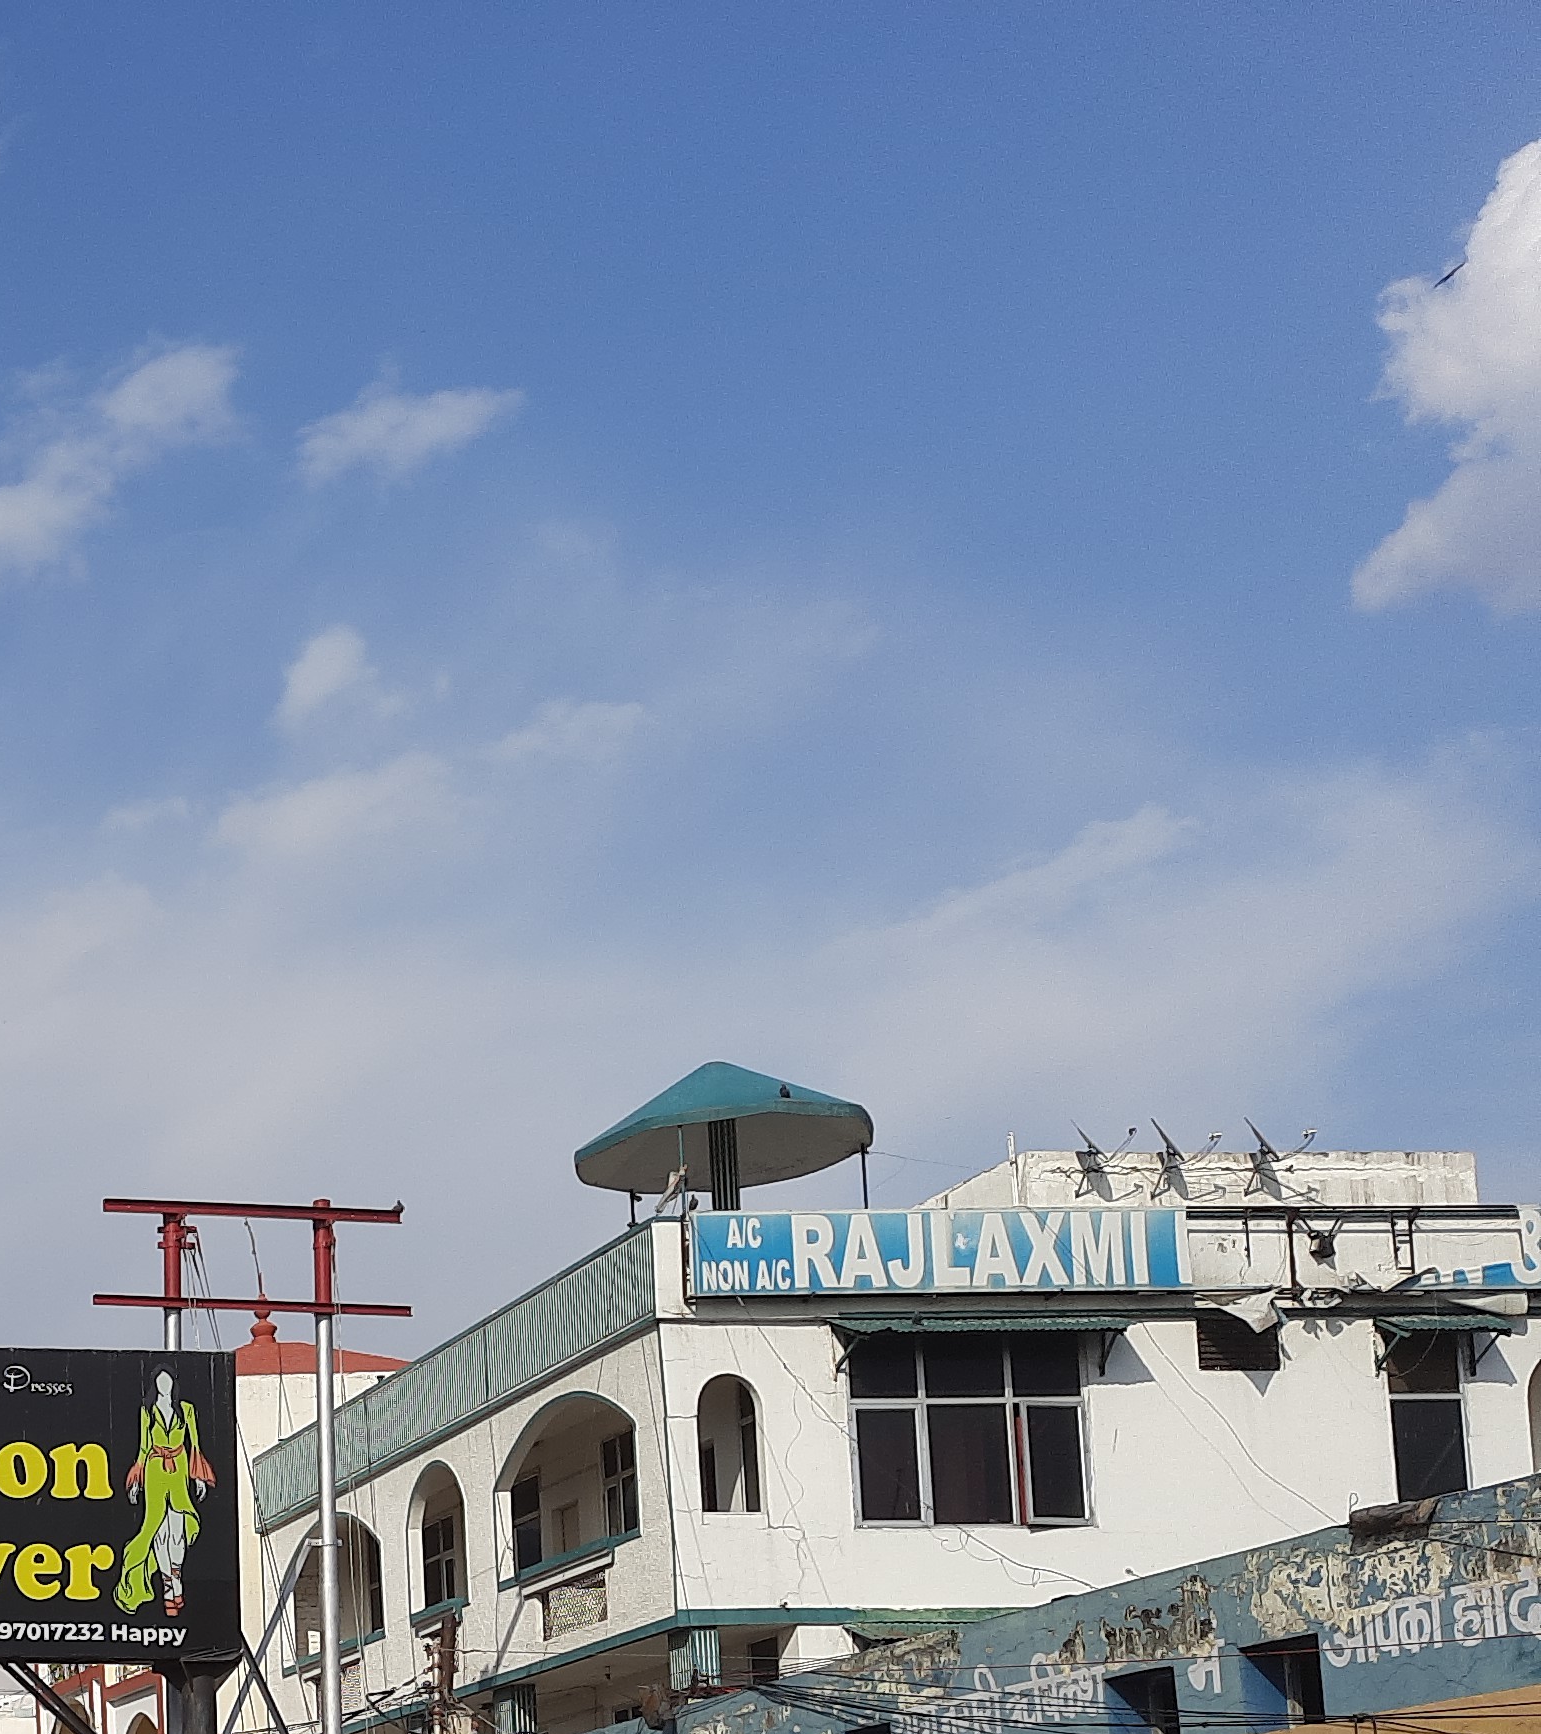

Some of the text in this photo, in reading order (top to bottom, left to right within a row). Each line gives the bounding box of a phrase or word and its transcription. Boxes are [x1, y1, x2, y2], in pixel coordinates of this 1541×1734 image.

[726, 1218, 762, 1250] A/C
[793, 1209, 1149, 1291] RAJLAXMI
[701, 1257, 793, 1293] NON A/C
[3, 1365, 74, 1396] Dresses
[111, 1624, 188, 1648] Happy
